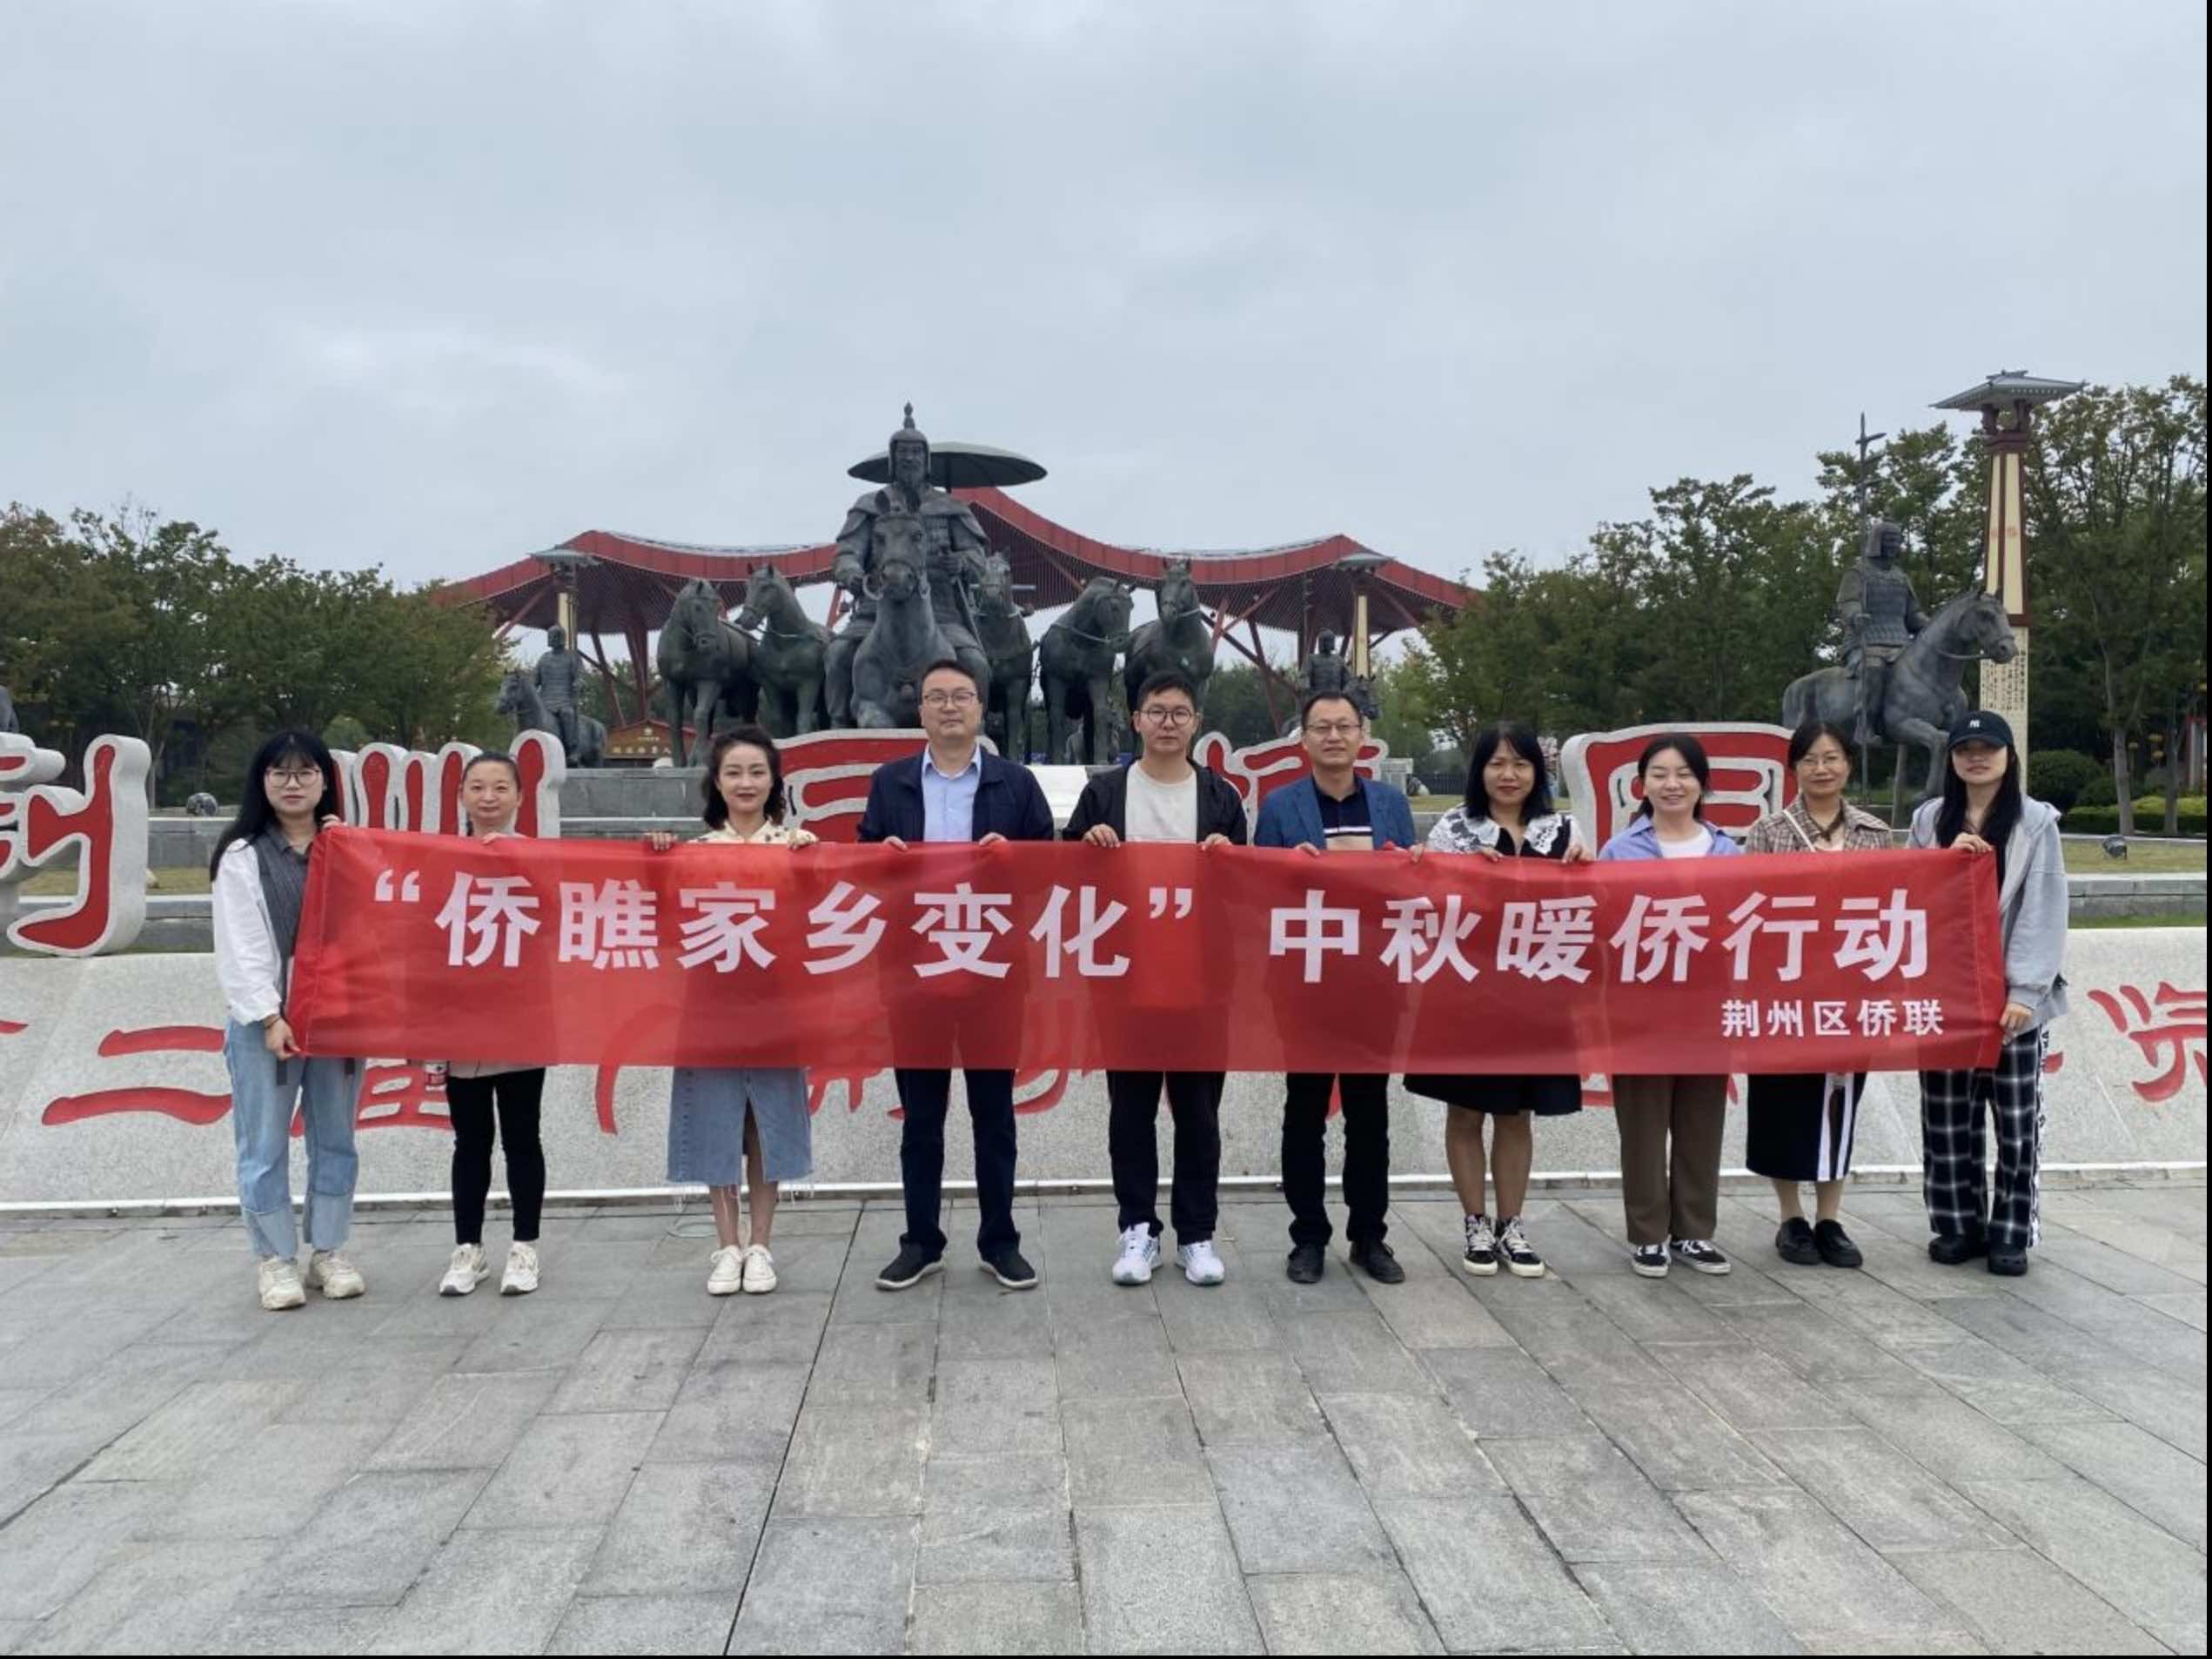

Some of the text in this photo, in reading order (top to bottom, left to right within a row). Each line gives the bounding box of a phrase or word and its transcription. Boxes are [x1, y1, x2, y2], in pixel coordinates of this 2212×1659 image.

[374, 869, 1929, 984] “侨瞧家乡变化” 中秋暖侨行动
[1721, 999, 1945, 1038] 荆州区侨联
